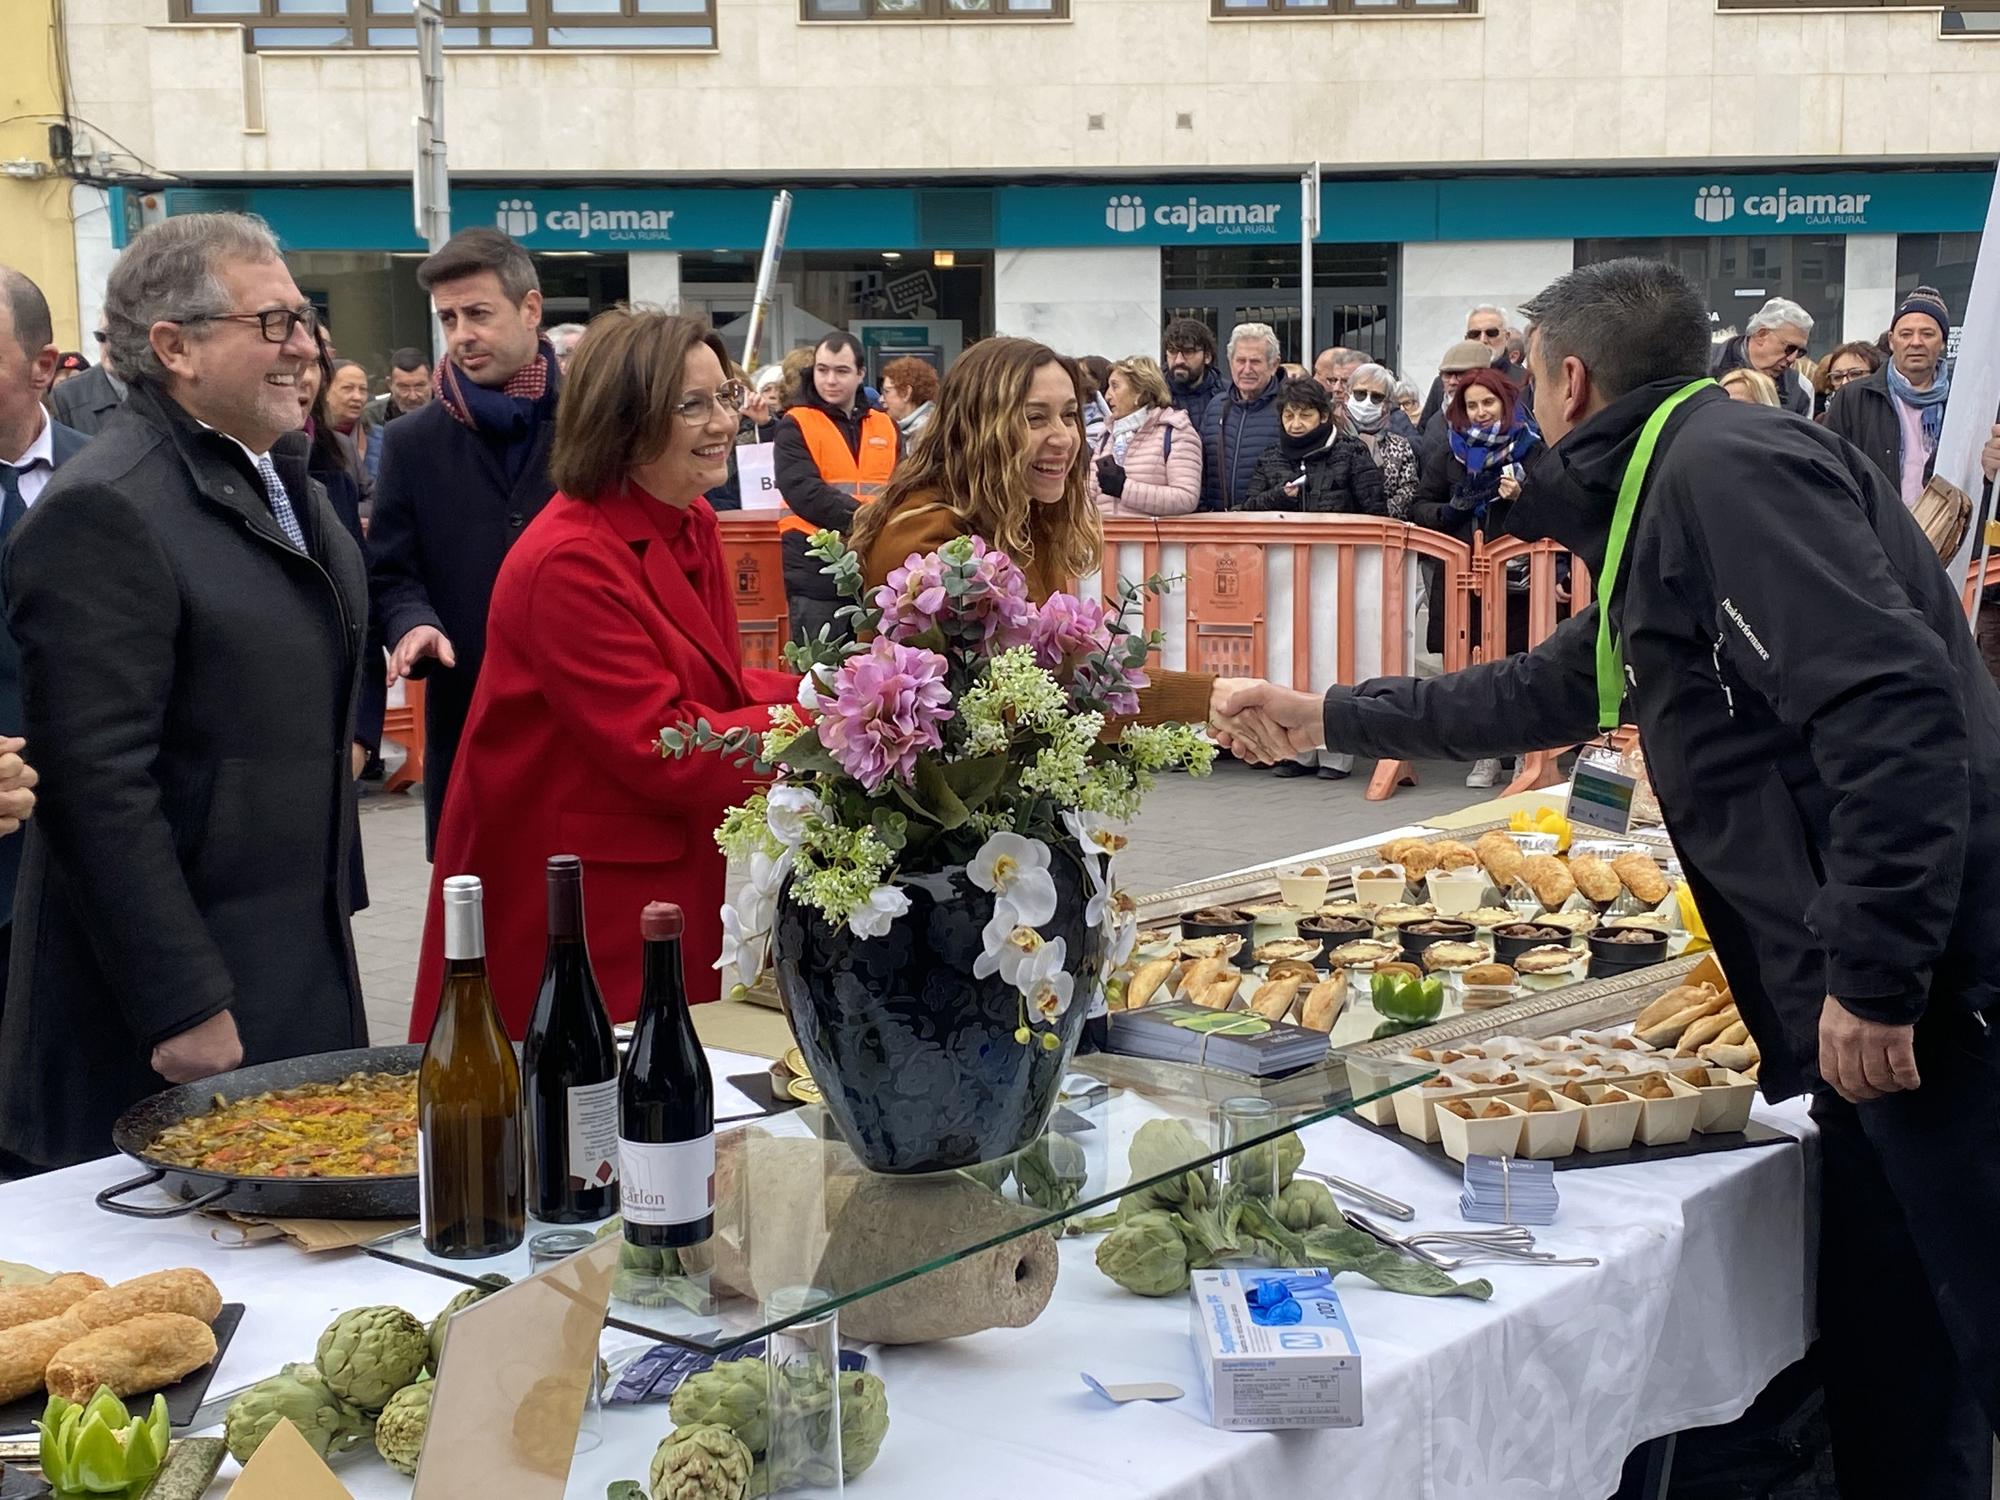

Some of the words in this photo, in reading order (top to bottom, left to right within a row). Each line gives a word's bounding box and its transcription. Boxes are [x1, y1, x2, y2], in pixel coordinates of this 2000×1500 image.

[1743, 187, 1871, 223] cajamar
[546, 203, 674, 238] cajamar
[1154, 197, 1281, 232] cajamar
[1806, 216, 1831, 224] CAJA
[1834, 215, 1867, 224] RURAL
[609, 232, 635, 240] CAJA
[637, 231, 672, 240] RURAL
[1216, 225, 1242, 234] CAJA
[1244, 225, 1277, 233] RURAL
[1271, 277, 1280, 289] 2
[1283, 1335, 1319, 1348] M
